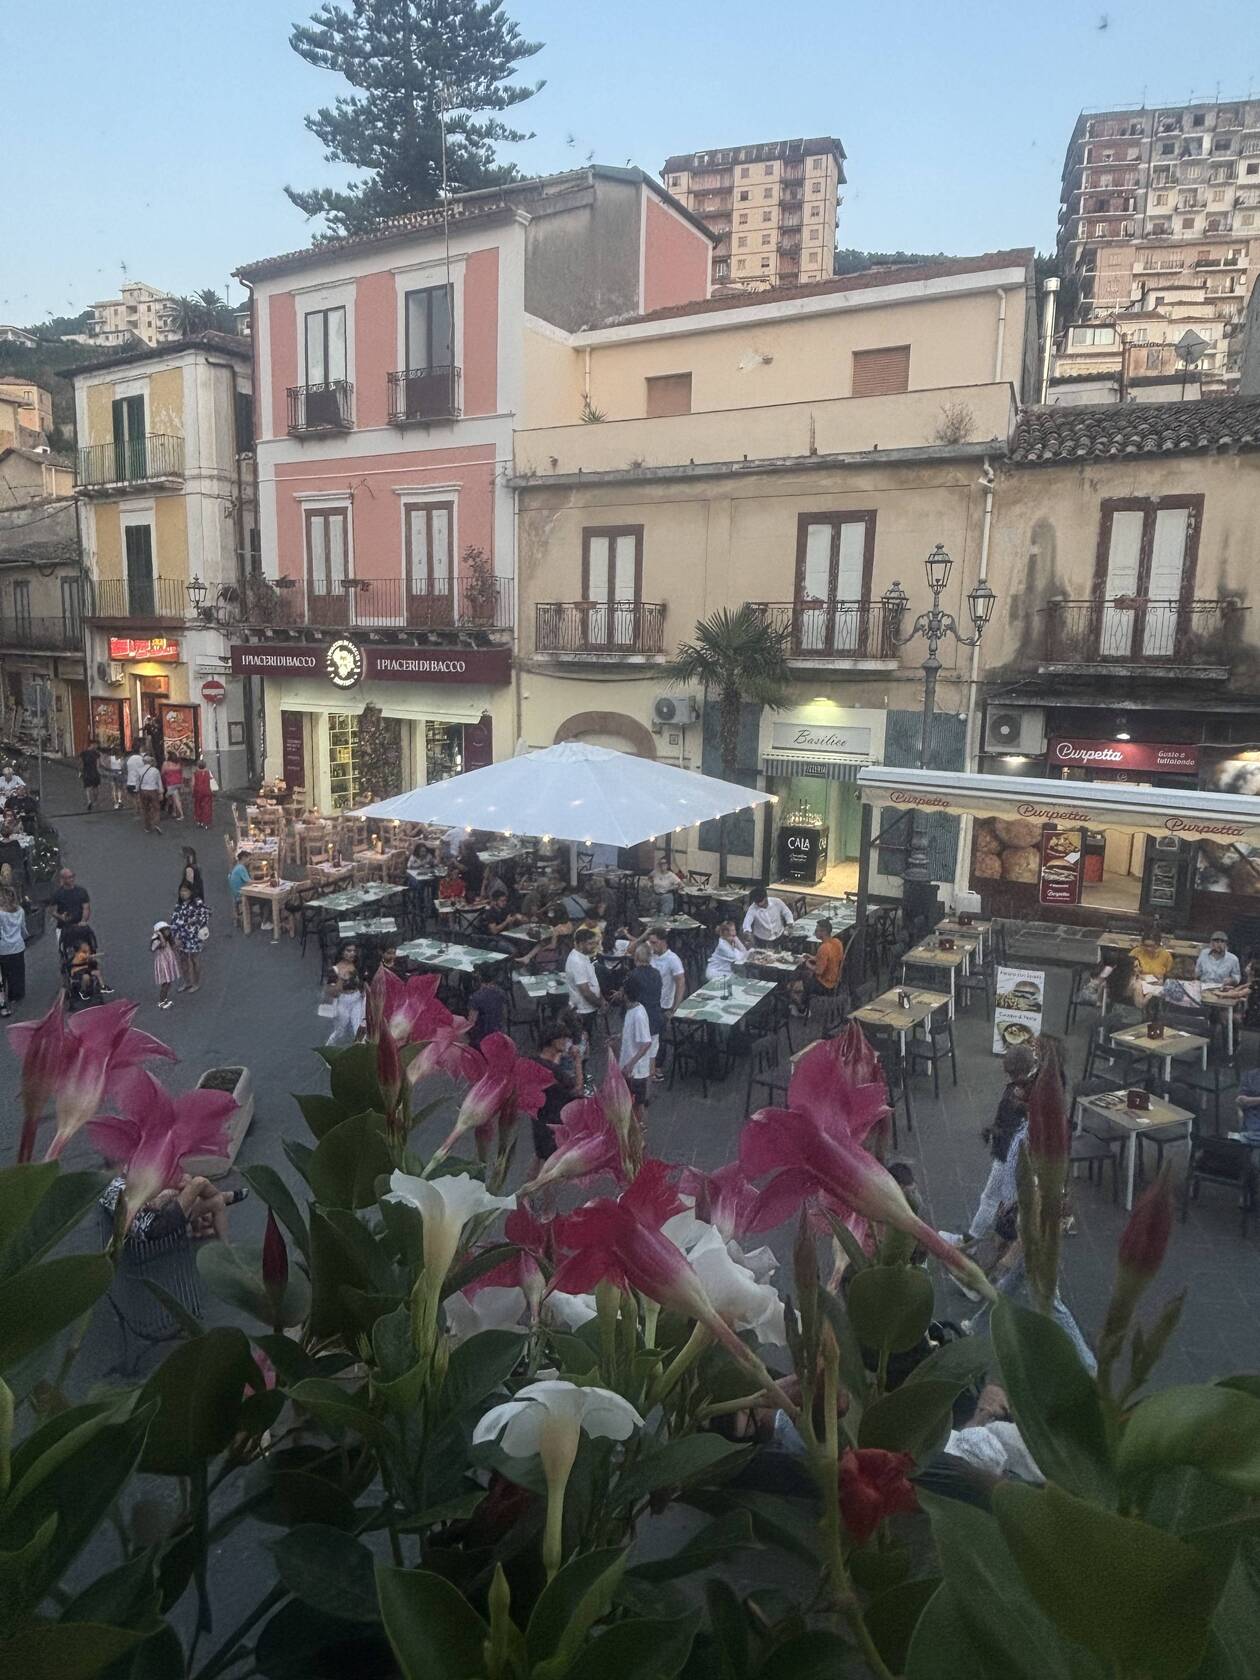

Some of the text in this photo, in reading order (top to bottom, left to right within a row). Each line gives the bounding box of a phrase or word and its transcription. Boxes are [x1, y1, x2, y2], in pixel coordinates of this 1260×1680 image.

[287, 657, 316, 667] BACCO
[382, 659, 419, 671] PIACERI
[420, 660, 430, 671] DI
[431, 661, 466, 673] BACCO
[1056, 742, 1124, 763] Purpetta
[889, 791, 951, 808] Purpetta
[1016, 803, 1091, 822] Purpetta
[1164, 816, 1245, 836] Purpetta
[787, 837, 810, 851] CALA
